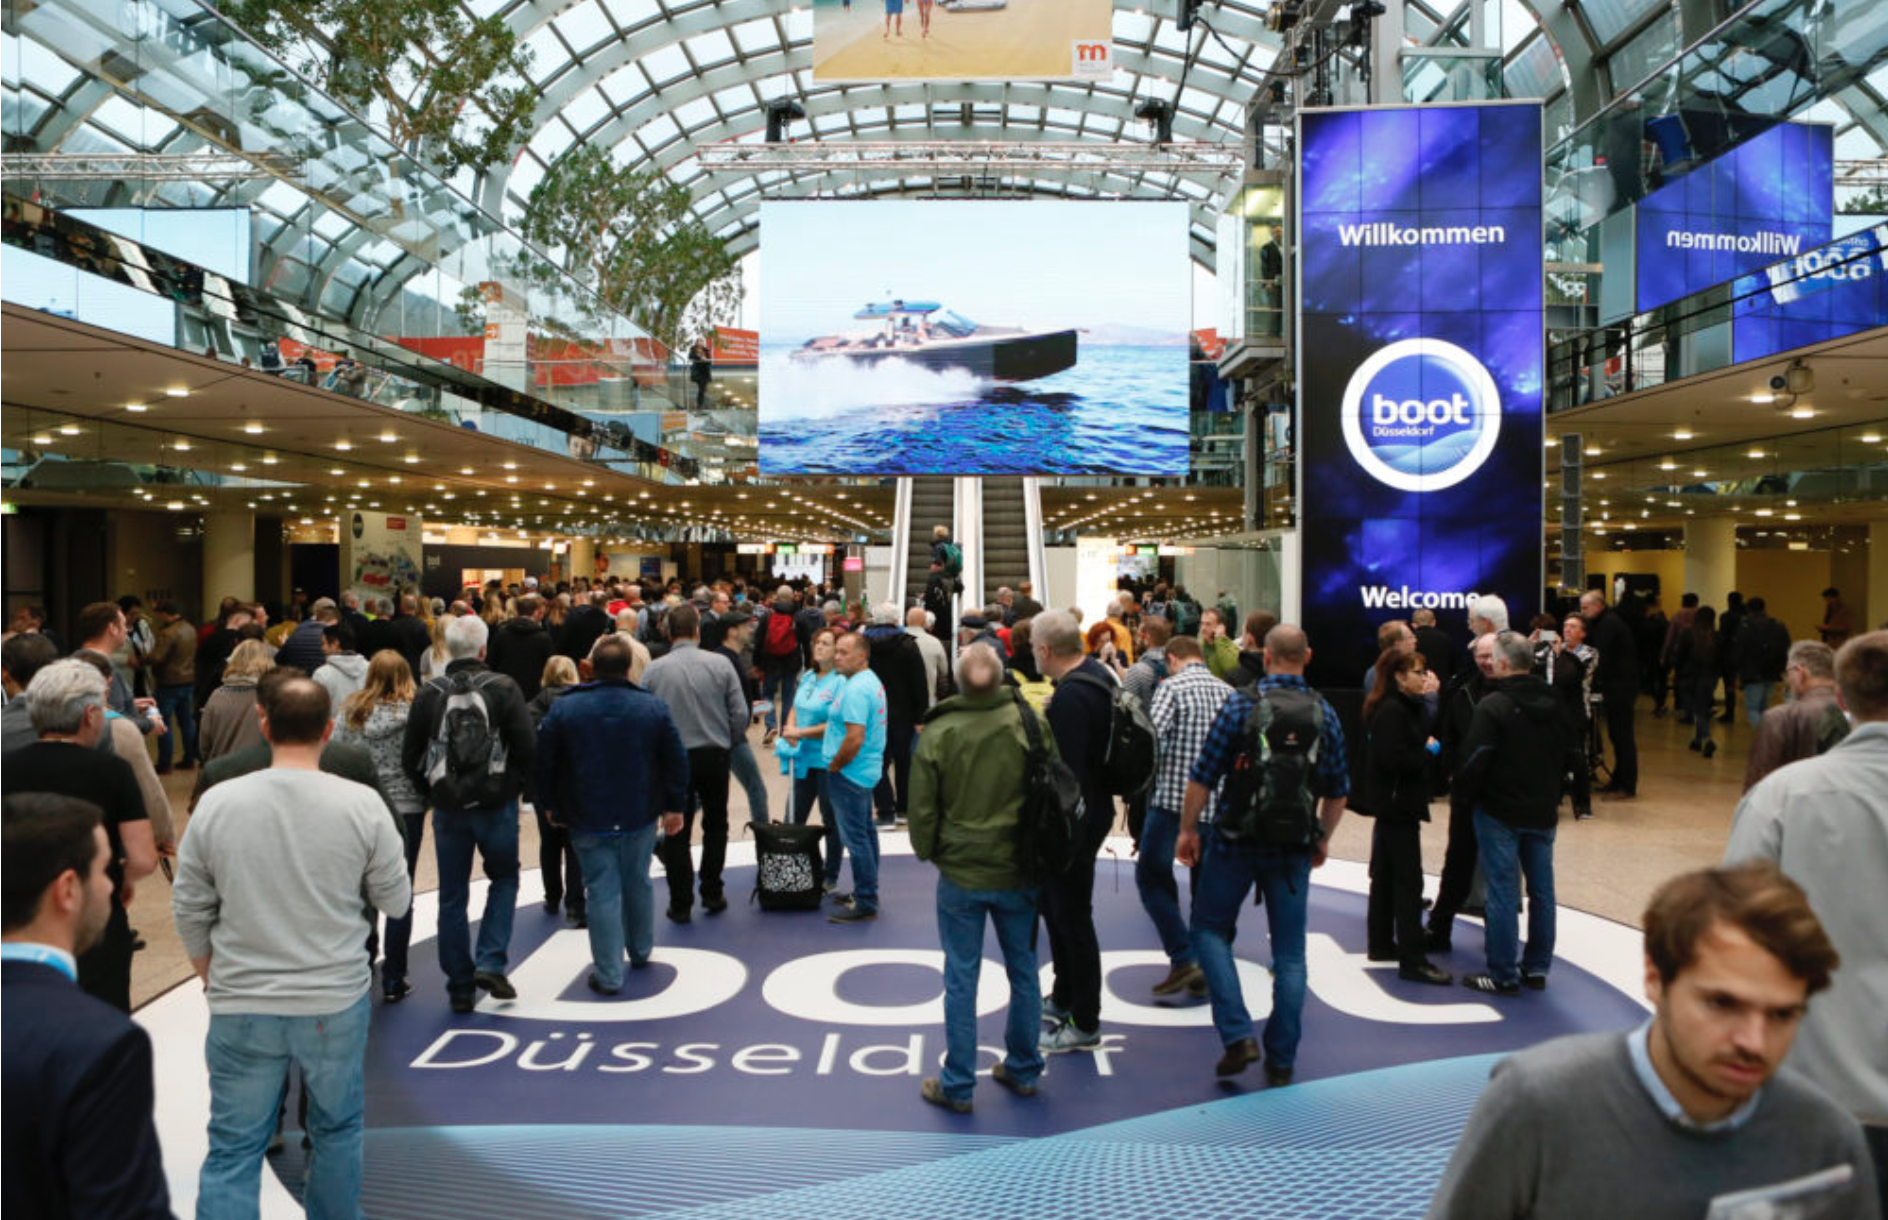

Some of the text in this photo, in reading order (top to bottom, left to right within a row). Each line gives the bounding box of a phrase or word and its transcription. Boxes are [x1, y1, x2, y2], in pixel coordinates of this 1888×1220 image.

[1338, 222, 1505, 247] Willkommen
[1372, 393, 1471, 425] boot
[1372, 425, 1435, 437] Düsseldorf
[408, 1028, 1128, 1076] Düsseldof
